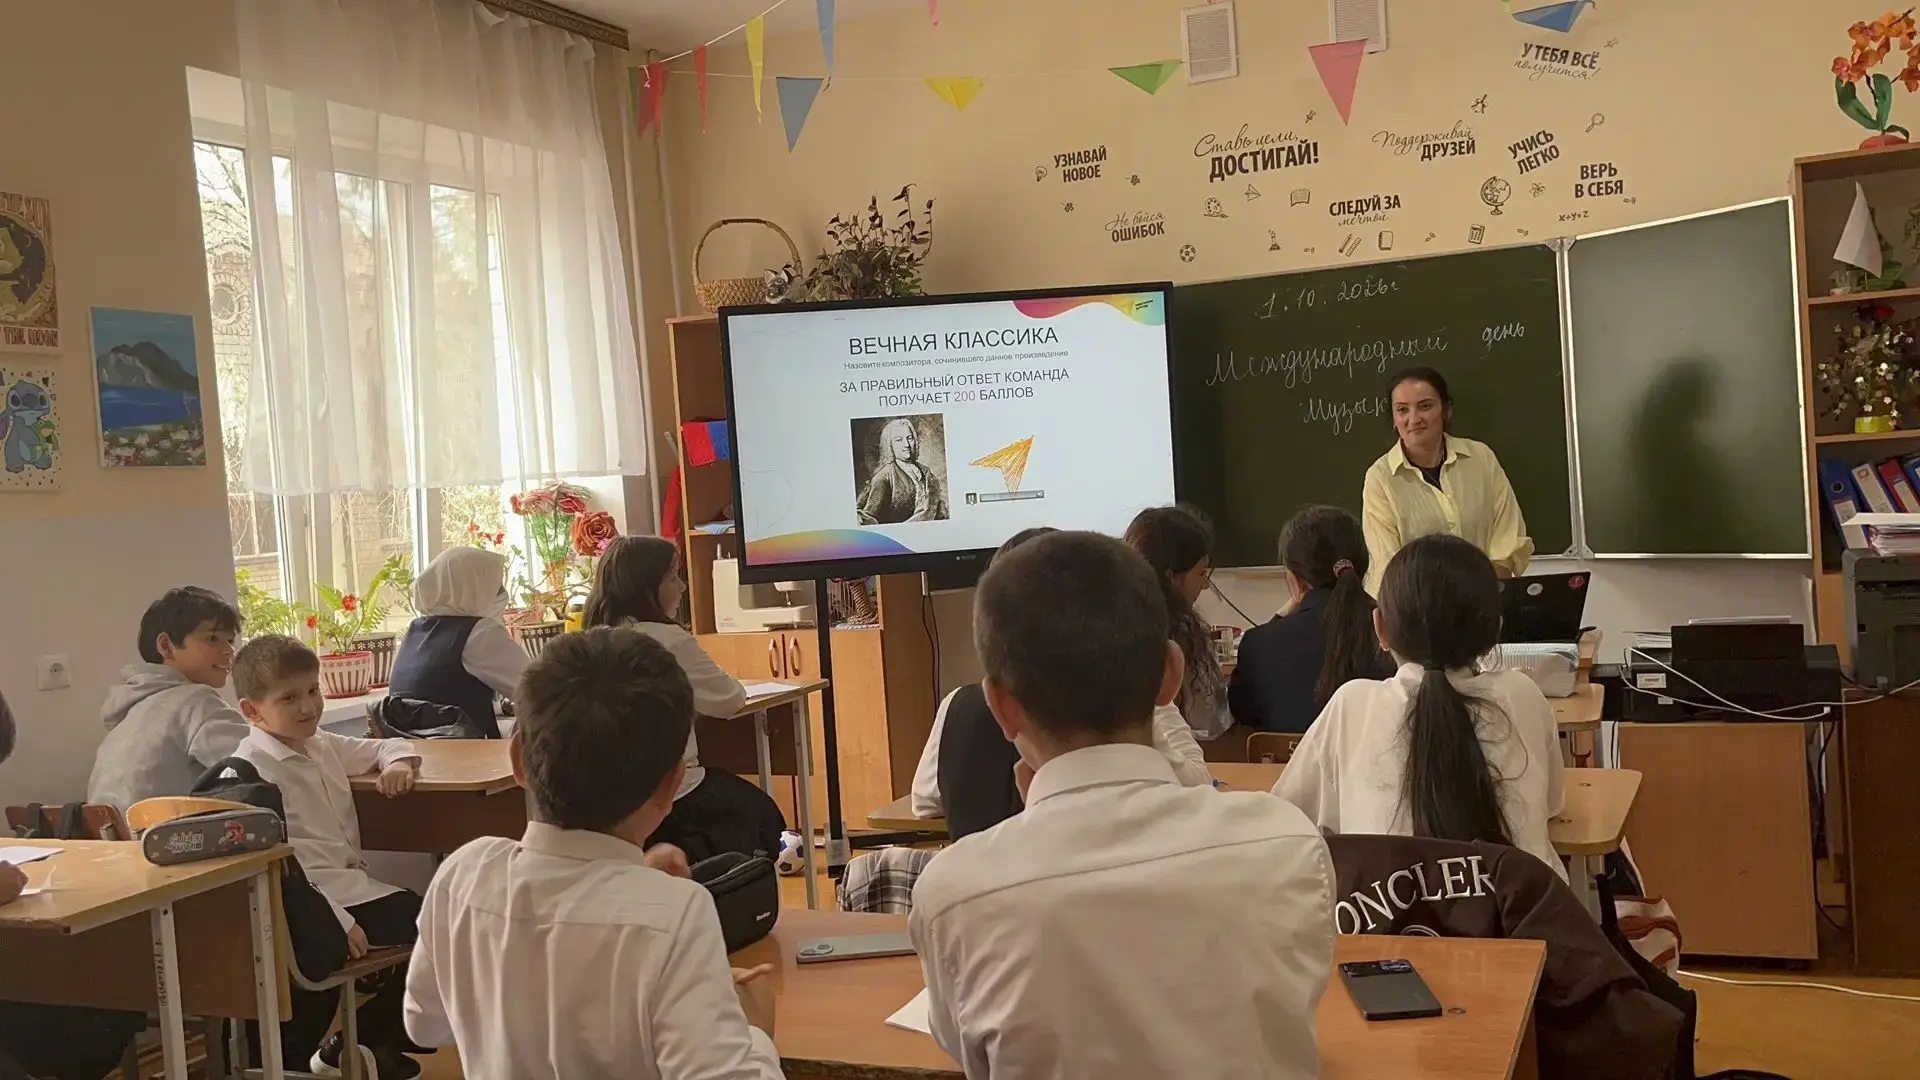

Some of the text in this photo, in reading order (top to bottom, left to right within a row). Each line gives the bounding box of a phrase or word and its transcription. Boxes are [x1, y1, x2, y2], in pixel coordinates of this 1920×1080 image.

[1521, 42, 1600, 70] У ТЕБЯ ВСЁ
[1513, 58, 1602, 82] получится!
[1194, 123, 1253, 158] Ставь
[1371, 119, 1474, 156] Поддерживай
[1420, 137, 1476, 162] ДРУЗЕЙ
[1508, 128, 1555, 160] УЧИСЬ
[1053, 145, 1107, 169] УЗНАВАЙ
[1209, 139, 1319, 183] ДОСТИГАЙ!
[1517, 144, 1561, 176] ЛЕГКО
[1062, 164, 1102, 184] НОВОЕ
[1580, 162, 1619, 180] ВЕРЬ
[1574, 179, 1625, 199] В СЕБЯ
[1329, 194, 1402, 217] СЛЕДУЙ ЗА
[1105, 211, 1129, 232] Не
[1111, 220, 1165, 243] ОШИБОК
[849, 326, 1060, 356] ВЕЧНАЯ КЛАССИКА
[843, 350, 1069, 370] Назовите композитора, сочинившего данное произведение
[1205, 321, 1526, 389] Международный день
[839, 367, 1070, 393] ЗА ПРАВИЛЬНЫЙ ОТВЕТ КОМАНДА
[878, 386, 1035, 407] ПОЛУЧАЕТ 200 БАЛЛОВ
[1334, 855, 1496, 936] ONCLER
